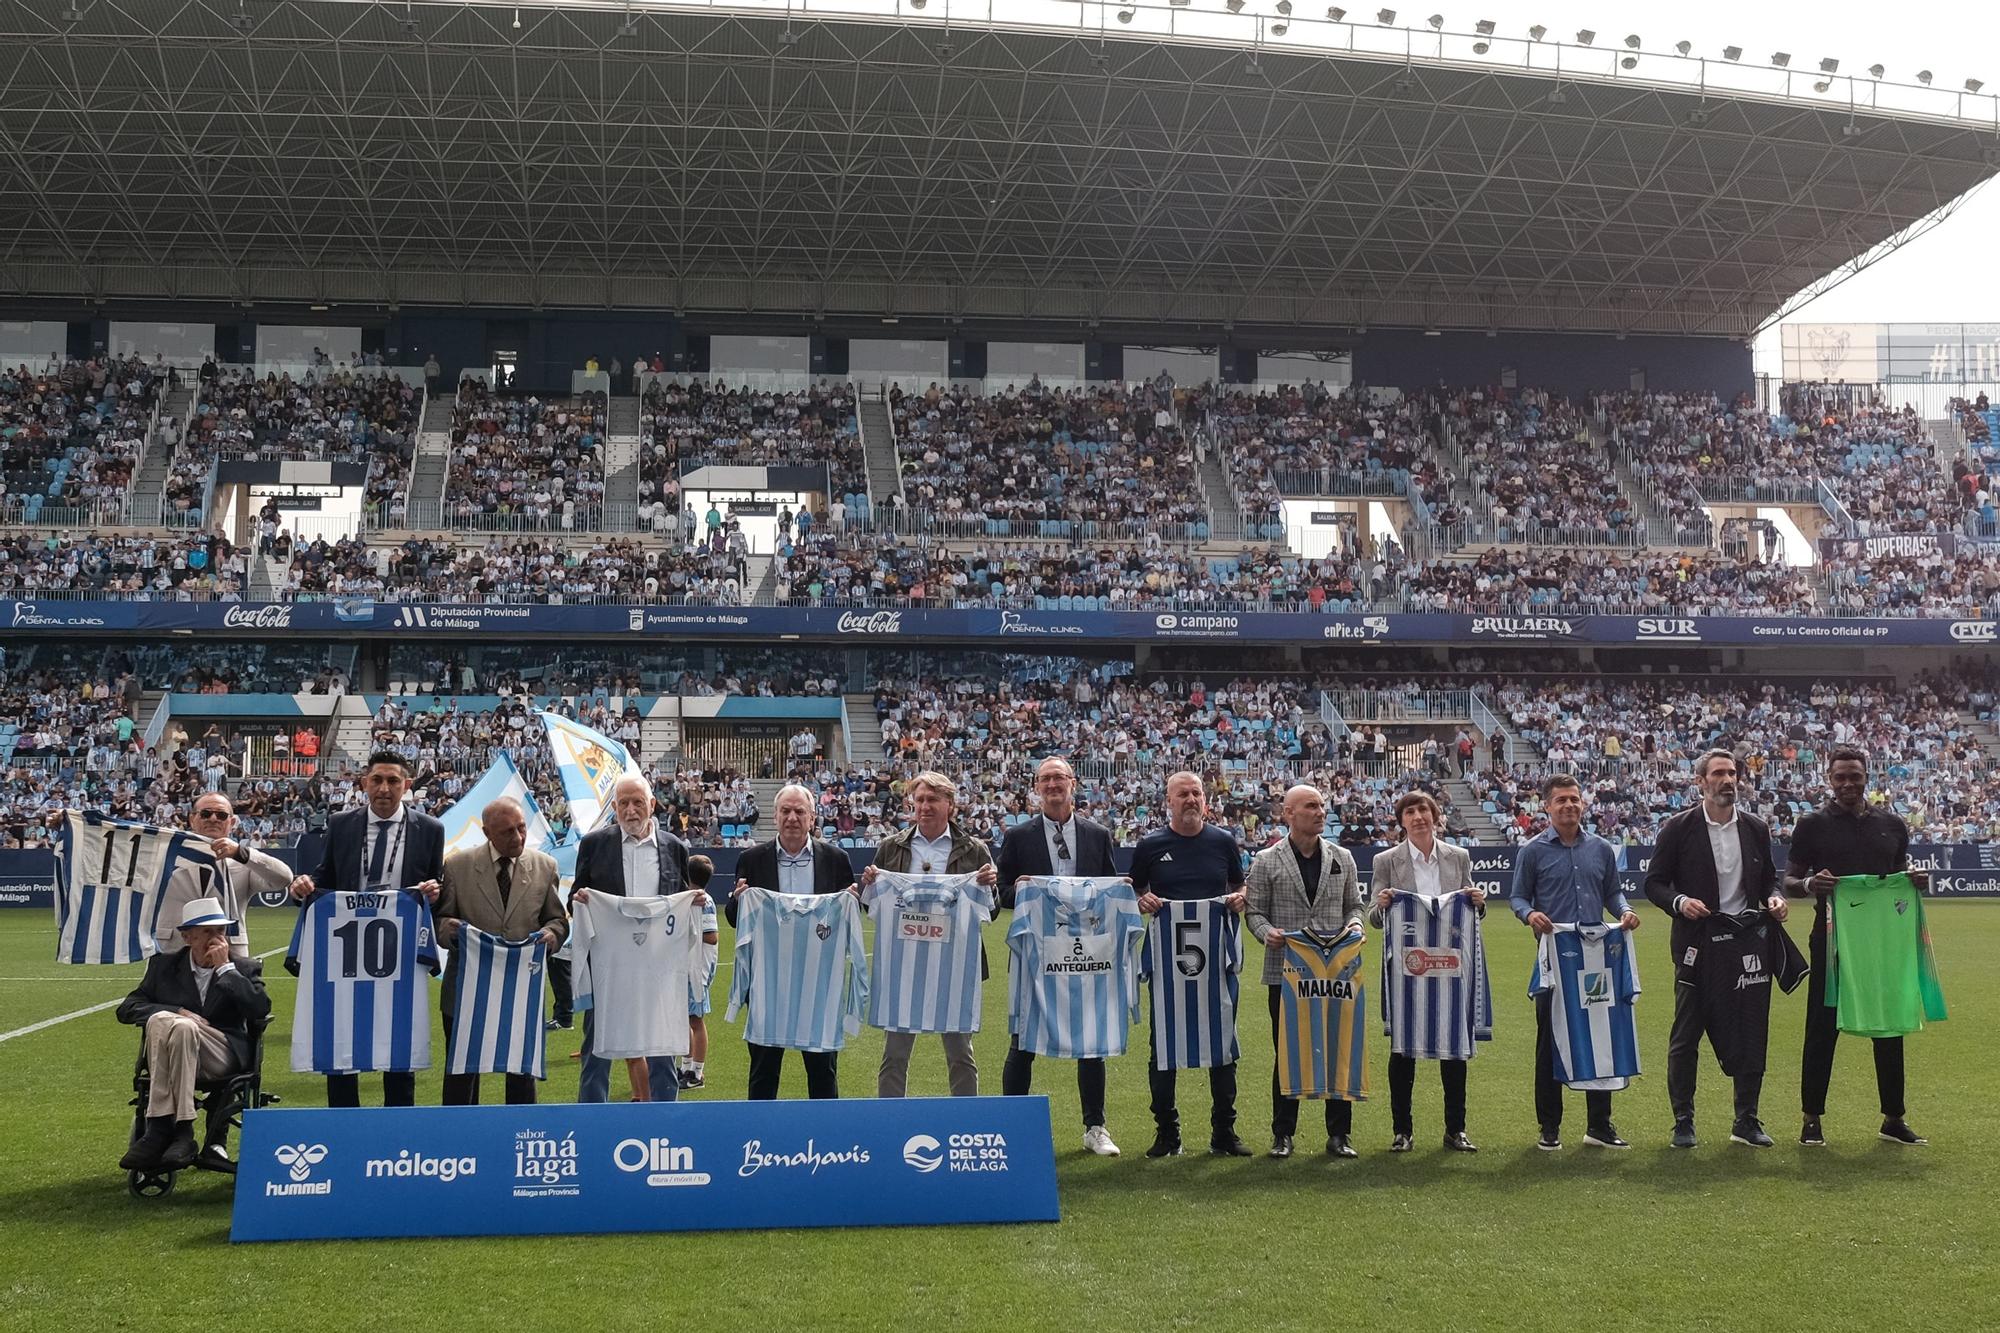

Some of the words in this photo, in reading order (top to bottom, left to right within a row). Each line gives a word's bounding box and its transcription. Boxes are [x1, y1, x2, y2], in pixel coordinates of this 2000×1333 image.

[223, 605, 293, 628] Coca-Cola
[430, 607, 482, 618] Diputación
[484, 607, 530, 617] Provincial
[648, 614, 704, 623] Ayuntamiento
[706, 615, 717, 623] de
[719, 615, 748, 624] Málaga
[430, 619, 443, 627] de
[445, 619, 480, 629] Málaga
[837, 610, 903, 633] Coca-Cola
[1180, 616, 1238, 630] campano
[1637, 618, 1698, 634] SUR
[1324, 622, 1365, 638] enPie.es
[1752, 625, 1785, 636] Cesur,
[1786, 626, 1797, 635] tu
[1798, 626, 1831, 636] Centro
[1831, 627, 1861, 636] Oficial
[1862, 627, 1875, 636] de
[1876, 627, 1889, 636] FP
[101, 830, 142, 887] 11
[1472, 880, 1501, 899] ga
[345, 893, 389, 910] BASTI
[665, 914, 675, 936] 9
[902, 913, 929, 922] DIARIO
[903, 924, 944, 938] SUR
[333, 918, 398, 978] 10
[1175, 922, 1207, 977] 5
[1046, 961, 1112, 973] ANTEQUERA
[1297, 979, 1353, 1000] MALAGA
[515, 1128, 546, 1139] sabor
[948, 1134, 1007, 1147] COSTA
[515, 1140, 524, 1150] a
[613, 1137, 693, 1172] Olin
[738, 1138, 870, 1177] Benahavis
[949, 1148, 977, 1160] DEL
[980, 1148, 1008, 1159] SOL
[515, 1152, 579, 1184] laga
[950, 1159, 1009, 1172] MÁLAGA
[265, 1179, 332, 1197] hummel
[513, 1188, 538, 1198] Málaga
[548, 1187, 580, 1196] Provincia
